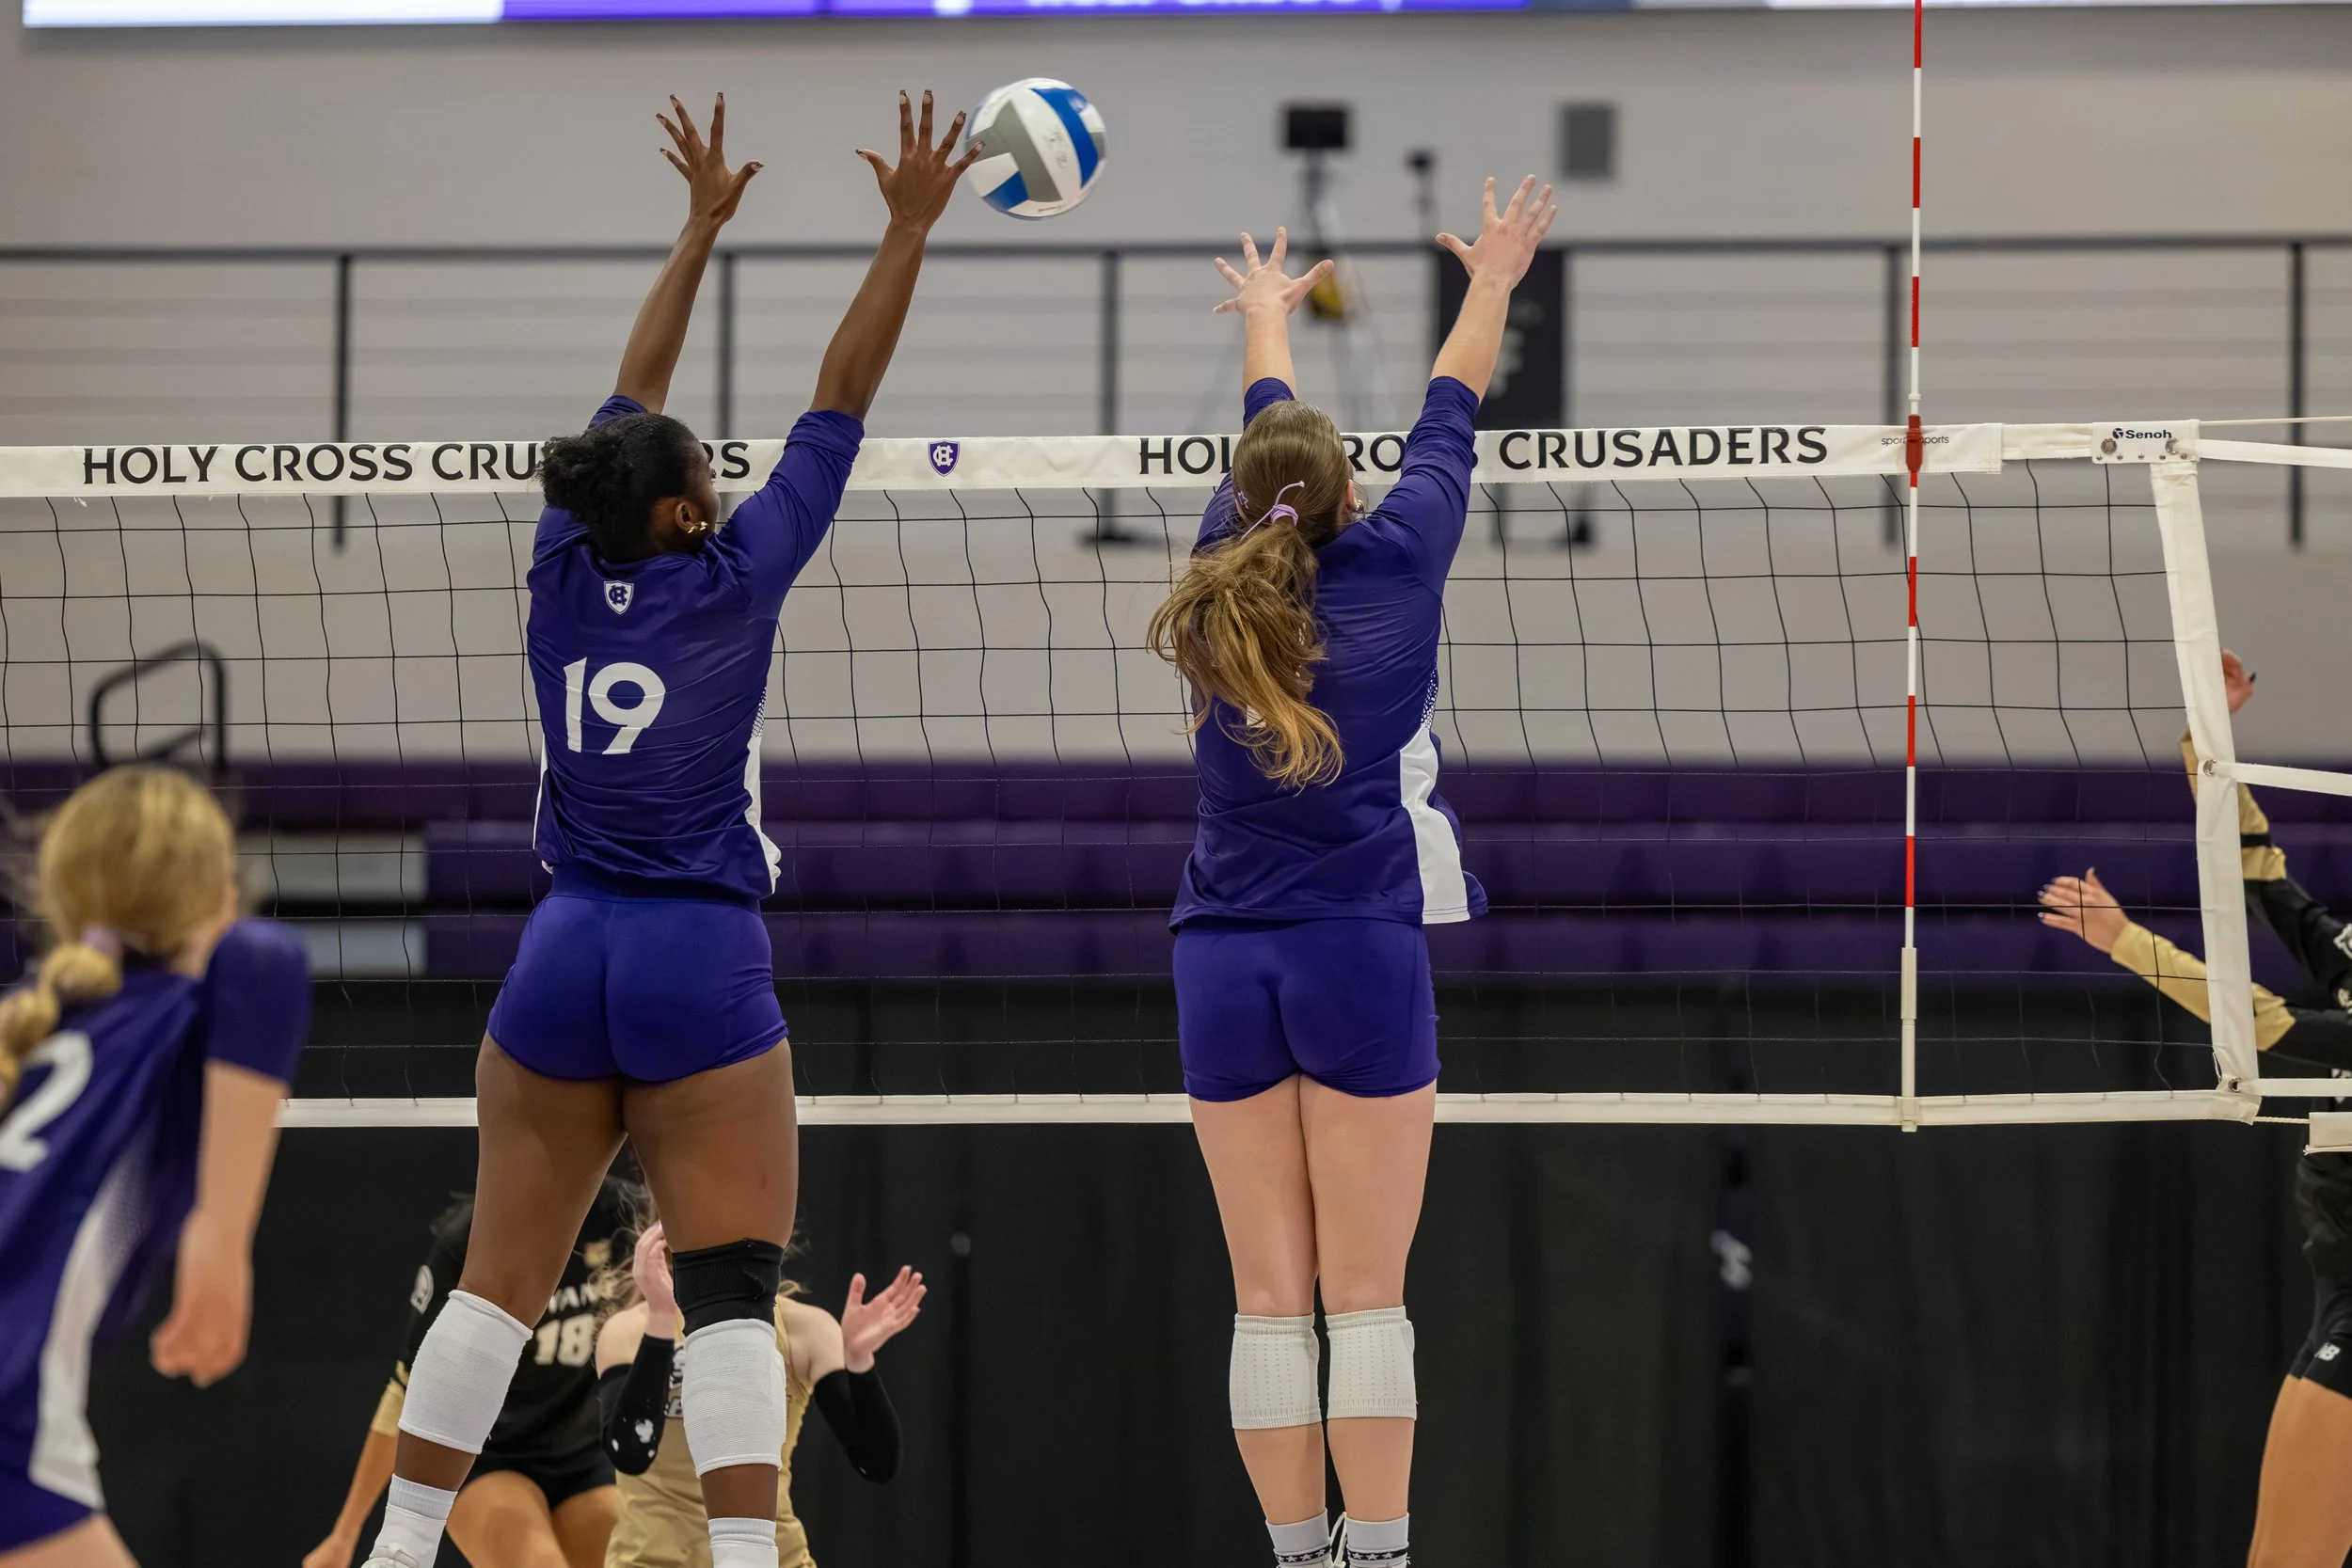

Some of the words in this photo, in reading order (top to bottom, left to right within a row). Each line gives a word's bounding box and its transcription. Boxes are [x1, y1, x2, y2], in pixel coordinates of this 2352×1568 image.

[1138, 436, 1232, 475] HOL
[1499, 426, 1828, 470] CRUSADERS
[2125, 429, 2172, 439] Senoh
[83, 446, 219, 484] HOLY
[234, 443, 414, 482] CROSS
[563, 657, 666, 754] 19
[534, 1314, 596, 1367] 18
